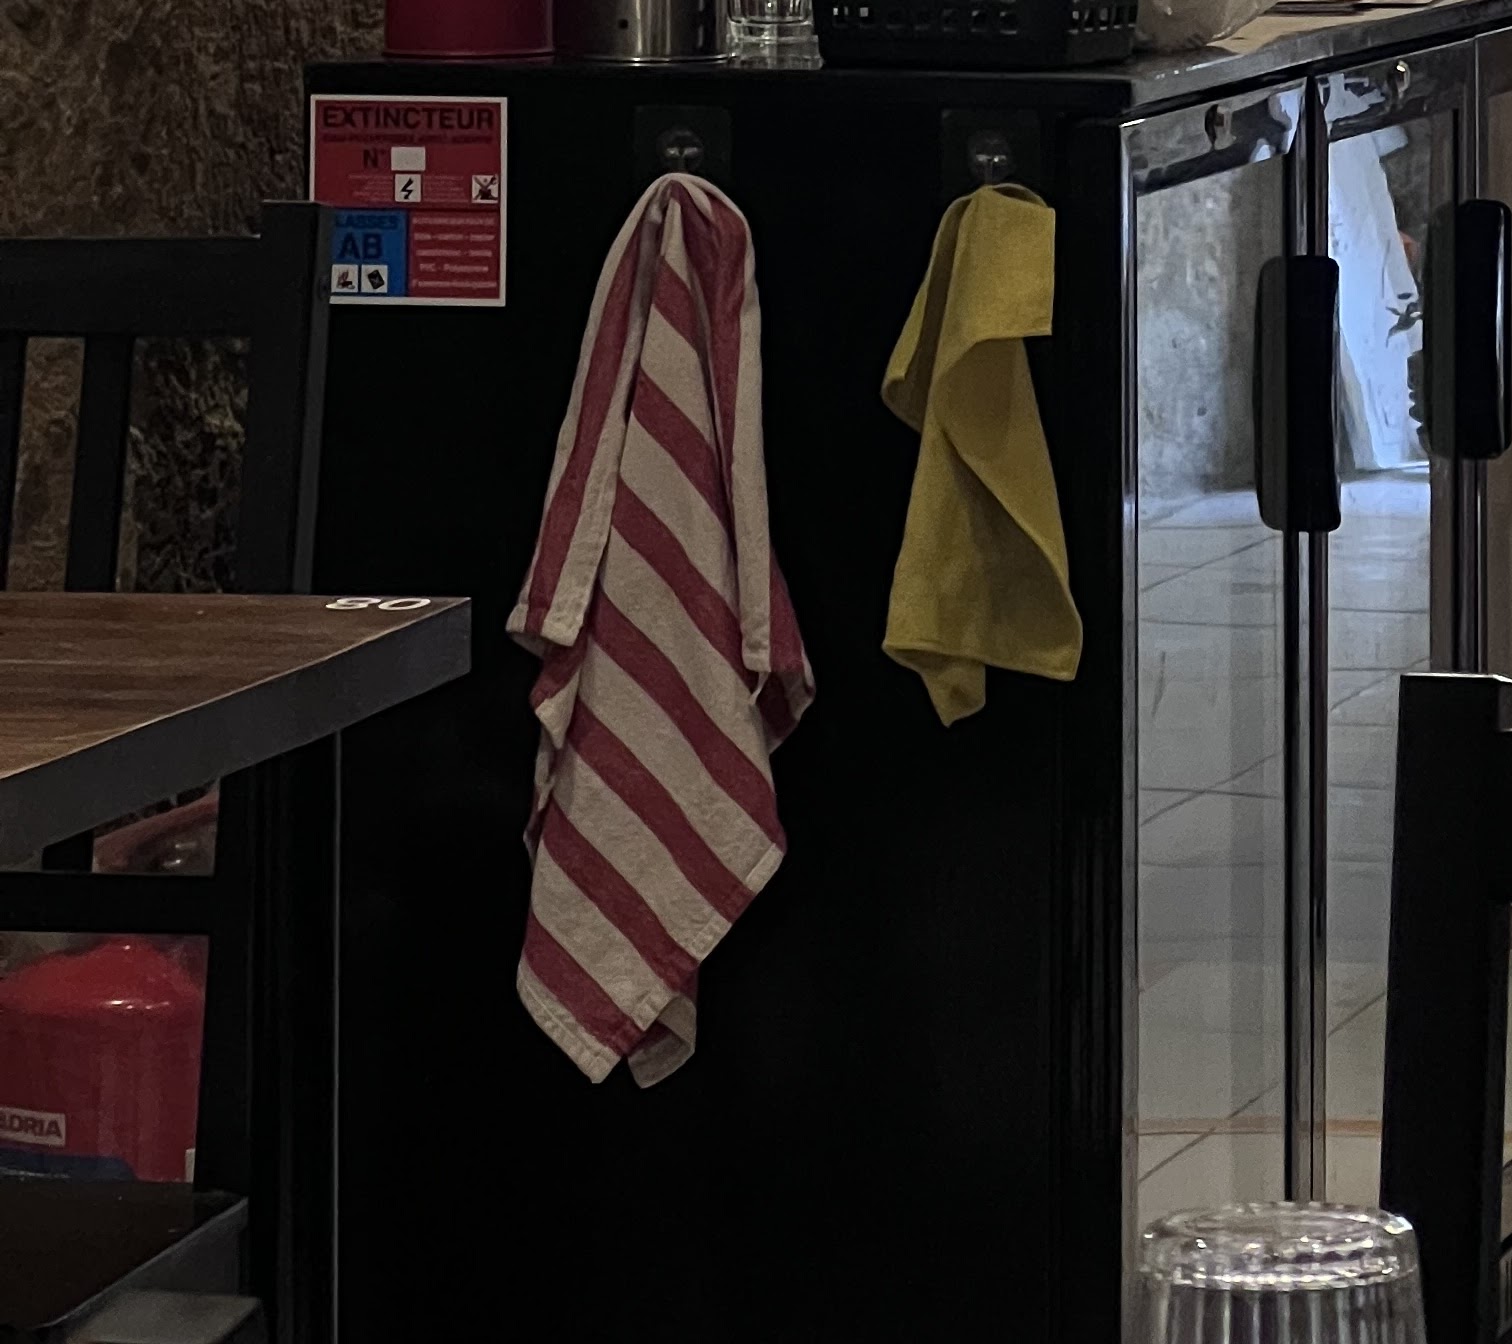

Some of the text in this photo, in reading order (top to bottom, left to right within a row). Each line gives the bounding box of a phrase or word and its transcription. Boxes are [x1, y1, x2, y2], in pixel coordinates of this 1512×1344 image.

[322, 105, 494, 130] EXTINCTEUR
[335, 214, 399, 231] LASSES
[339, 232, 384, 259] AB
[0, 1113, 63, 1139] ORIA
